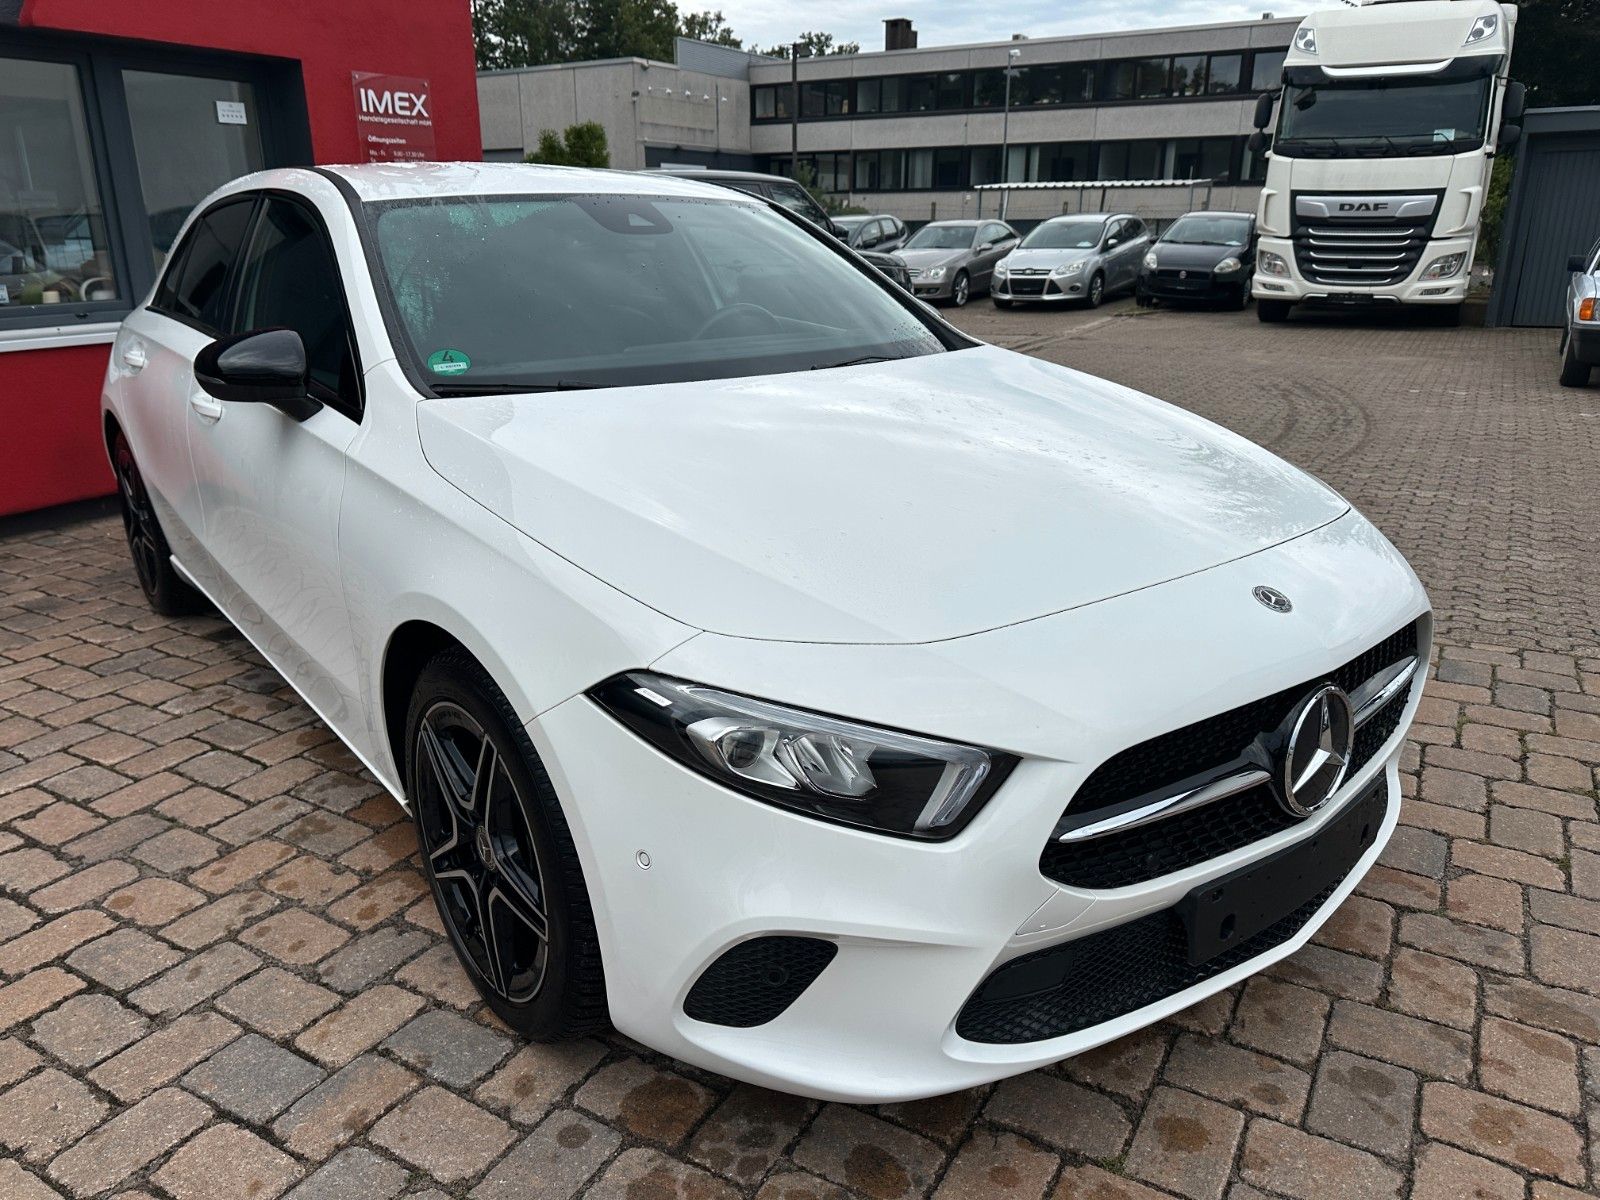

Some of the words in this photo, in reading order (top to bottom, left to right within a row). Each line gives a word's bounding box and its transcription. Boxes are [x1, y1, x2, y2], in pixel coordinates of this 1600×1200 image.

[360, 88, 429, 117] IMEX
[1339, 203, 1388, 211] DAF
[442, 350, 454, 362] 4
